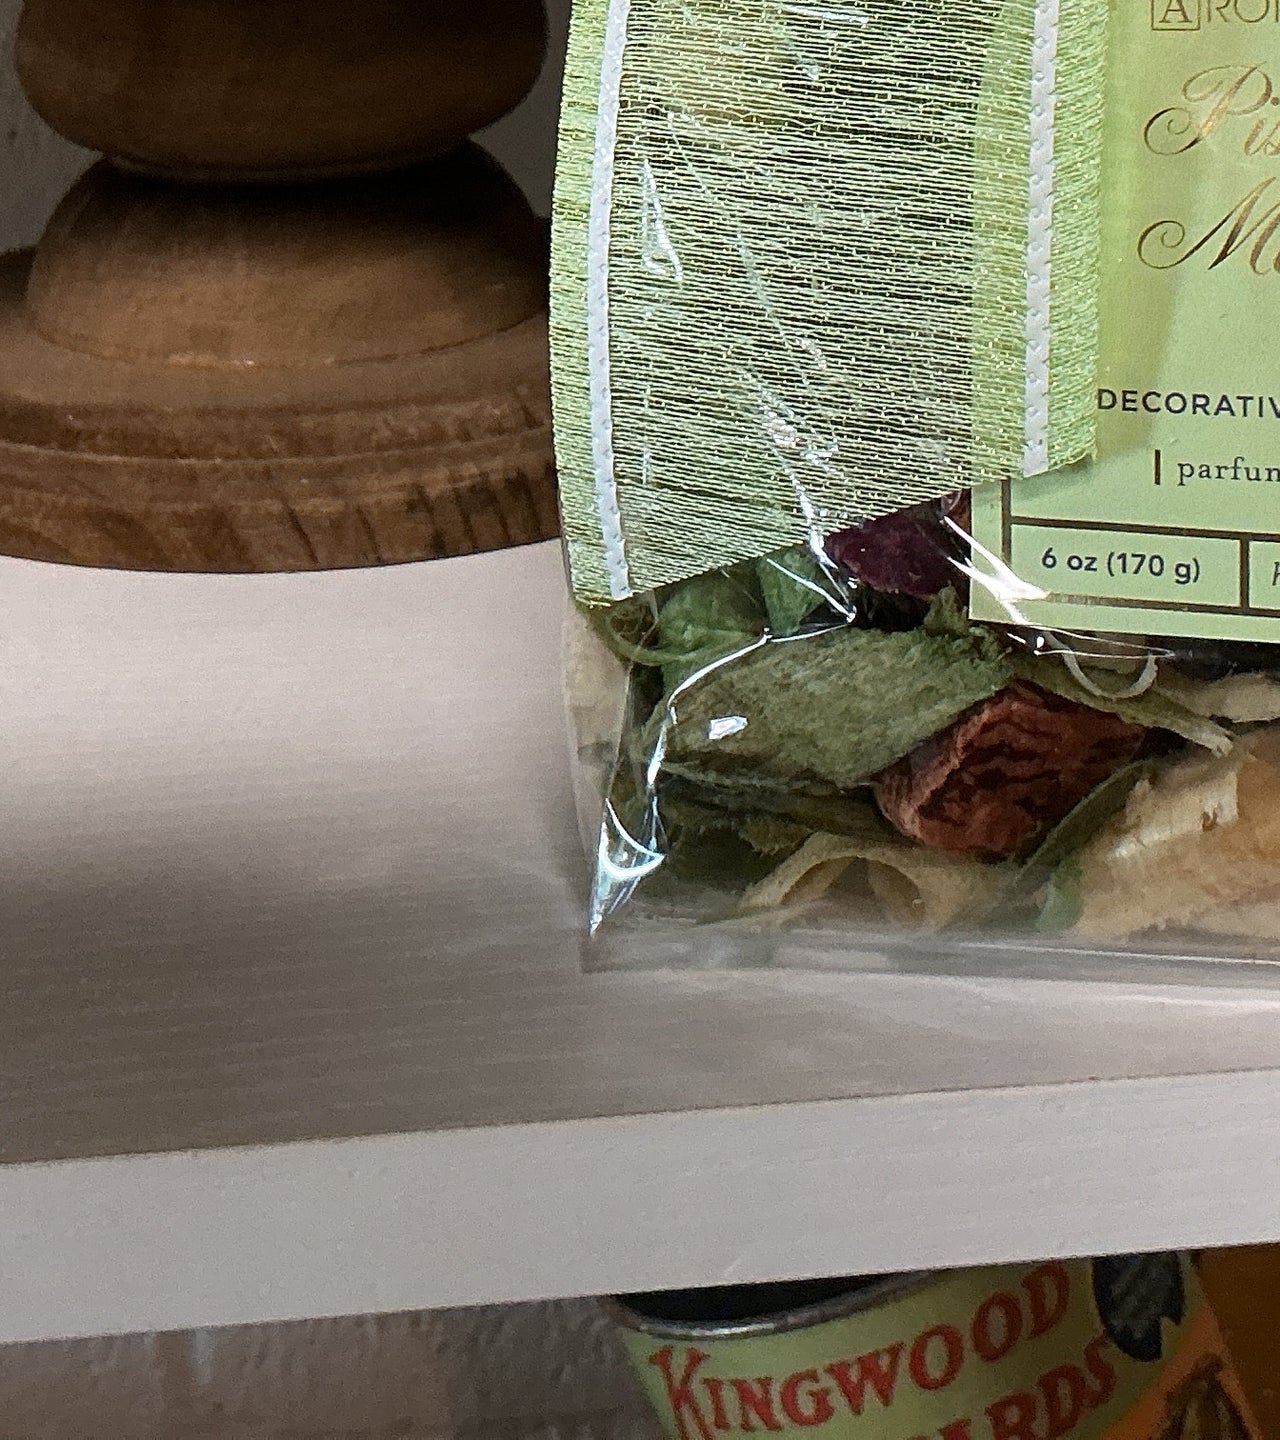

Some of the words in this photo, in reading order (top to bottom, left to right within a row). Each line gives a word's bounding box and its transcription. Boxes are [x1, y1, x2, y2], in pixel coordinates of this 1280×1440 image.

[1041, 546, 1058, 570] 6
[1066, 554, 1098, 572] oz
[1106, 551, 1166, 578] (170
[1174, 557, 1201, 585] g)
[648, 1261, 1071, 1440] KINGWOOD
